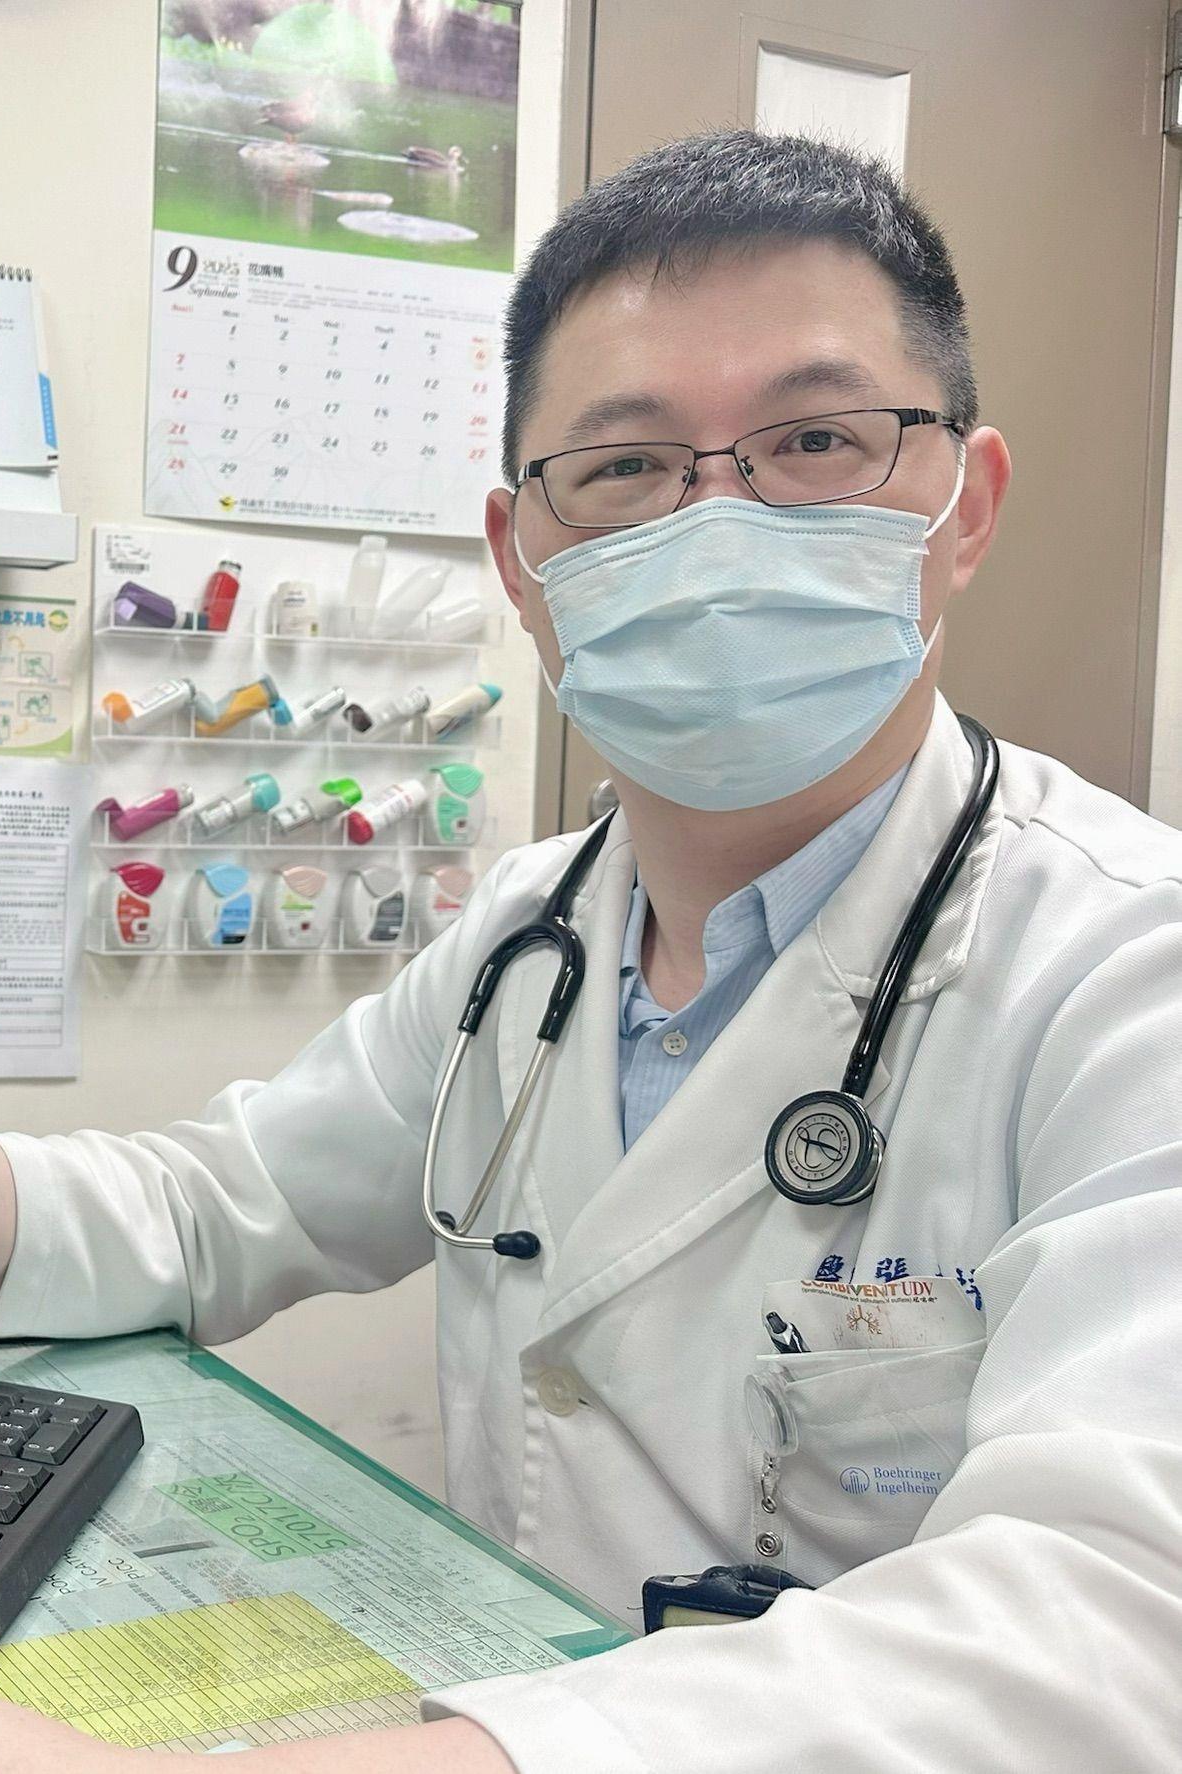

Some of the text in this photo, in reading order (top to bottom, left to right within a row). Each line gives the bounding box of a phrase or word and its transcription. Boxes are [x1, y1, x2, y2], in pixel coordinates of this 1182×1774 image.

[162, 245, 198, 292] 9
[187, 283, 239, 299] September
[901, 1280, 934, 1297] UDV
[873, 1466, 943, 1482] Boehringer
[875, 1481, 939, 1496] Ingelheim
[108, 1556, 147, 1582] PICC
